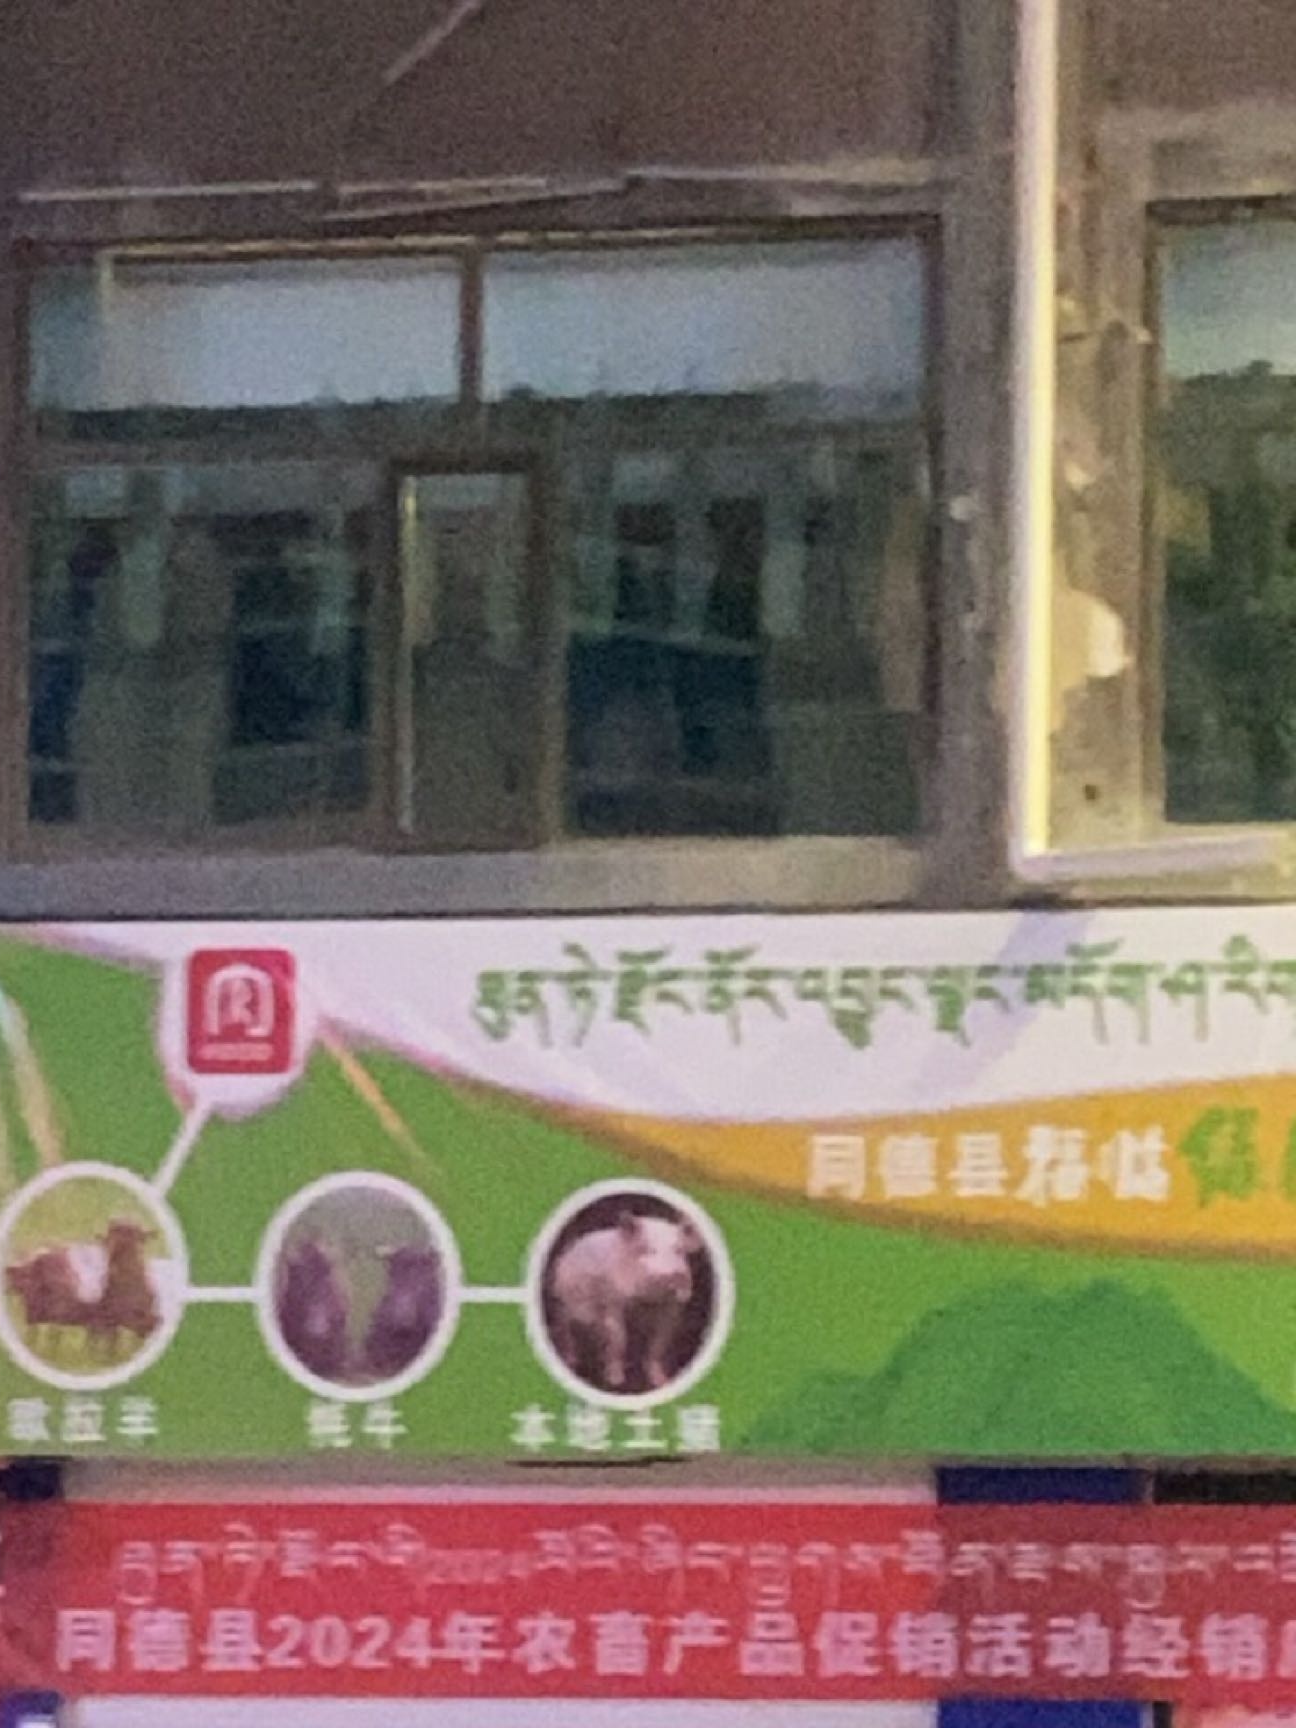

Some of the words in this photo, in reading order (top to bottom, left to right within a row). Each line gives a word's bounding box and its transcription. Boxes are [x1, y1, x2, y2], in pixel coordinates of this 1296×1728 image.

[55, 1607, 1296, 1680] 同德县2024年农畜产品促销活动经销
